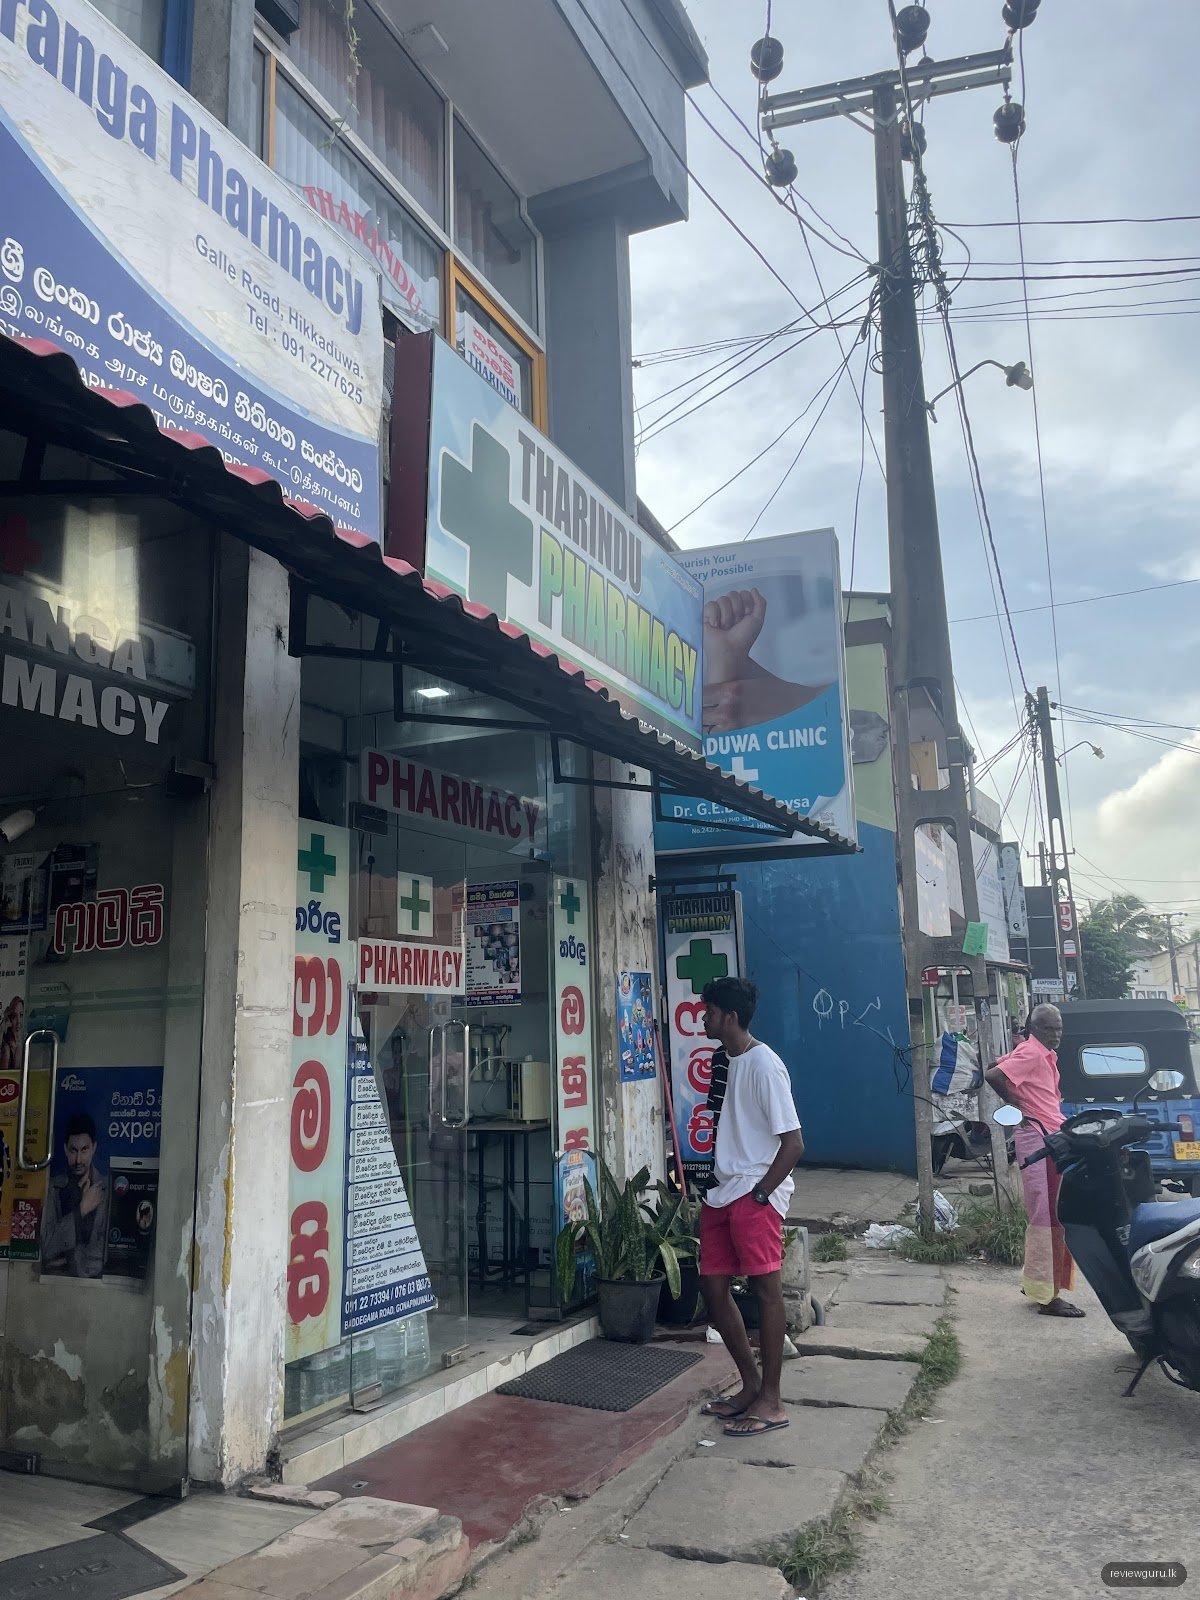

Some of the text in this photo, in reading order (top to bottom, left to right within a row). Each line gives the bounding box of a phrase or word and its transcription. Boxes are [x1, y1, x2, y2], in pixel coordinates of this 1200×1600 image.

[170, 102, 363, 336] Pharmacy
[303, 186, 422, 315] THARINDU
[33, 267, 100, 325] ලංකා
[108, 312, 164, 366] රාජ්‍ය
[196, 234, 364, 379] Galle Road, Hikkaduwa.
[105, 357, 148, 387] அரச
[247, 303, 268, 336] Tel
[282, 332, 305, 363] 091
[311, 352, 363, 405] 2277625
[468, 350, 522, 412] THARINDU
[518, 429, 642, 595] THARINDU
[711, 563, 754, 578] Possible
[713, 553, 736, 565] Your
[538, 527, 697, 721] PHARMACY
[2, 654, 169, 744] MACY
[767, 726, 827, 750] CLINIC
[368, 751, 540, 843] PHARMACY
[674, 805, 692, 818] Dr.
[667, 896, 731, 916] THARINDU
[667, 915, 731, 934] PHARMACY
[360, 943, 463, 988] PHARMACY
[147, 1088, 155, 1106] 5
[18, 1201, 33, 1212] Rs.
[359, 1296, 369, 1310] 22
[369, 1288, 390, 1306] 73394
[394, 1285, 407, 1299] 076
[407, 1281, 416, 1294] 03
